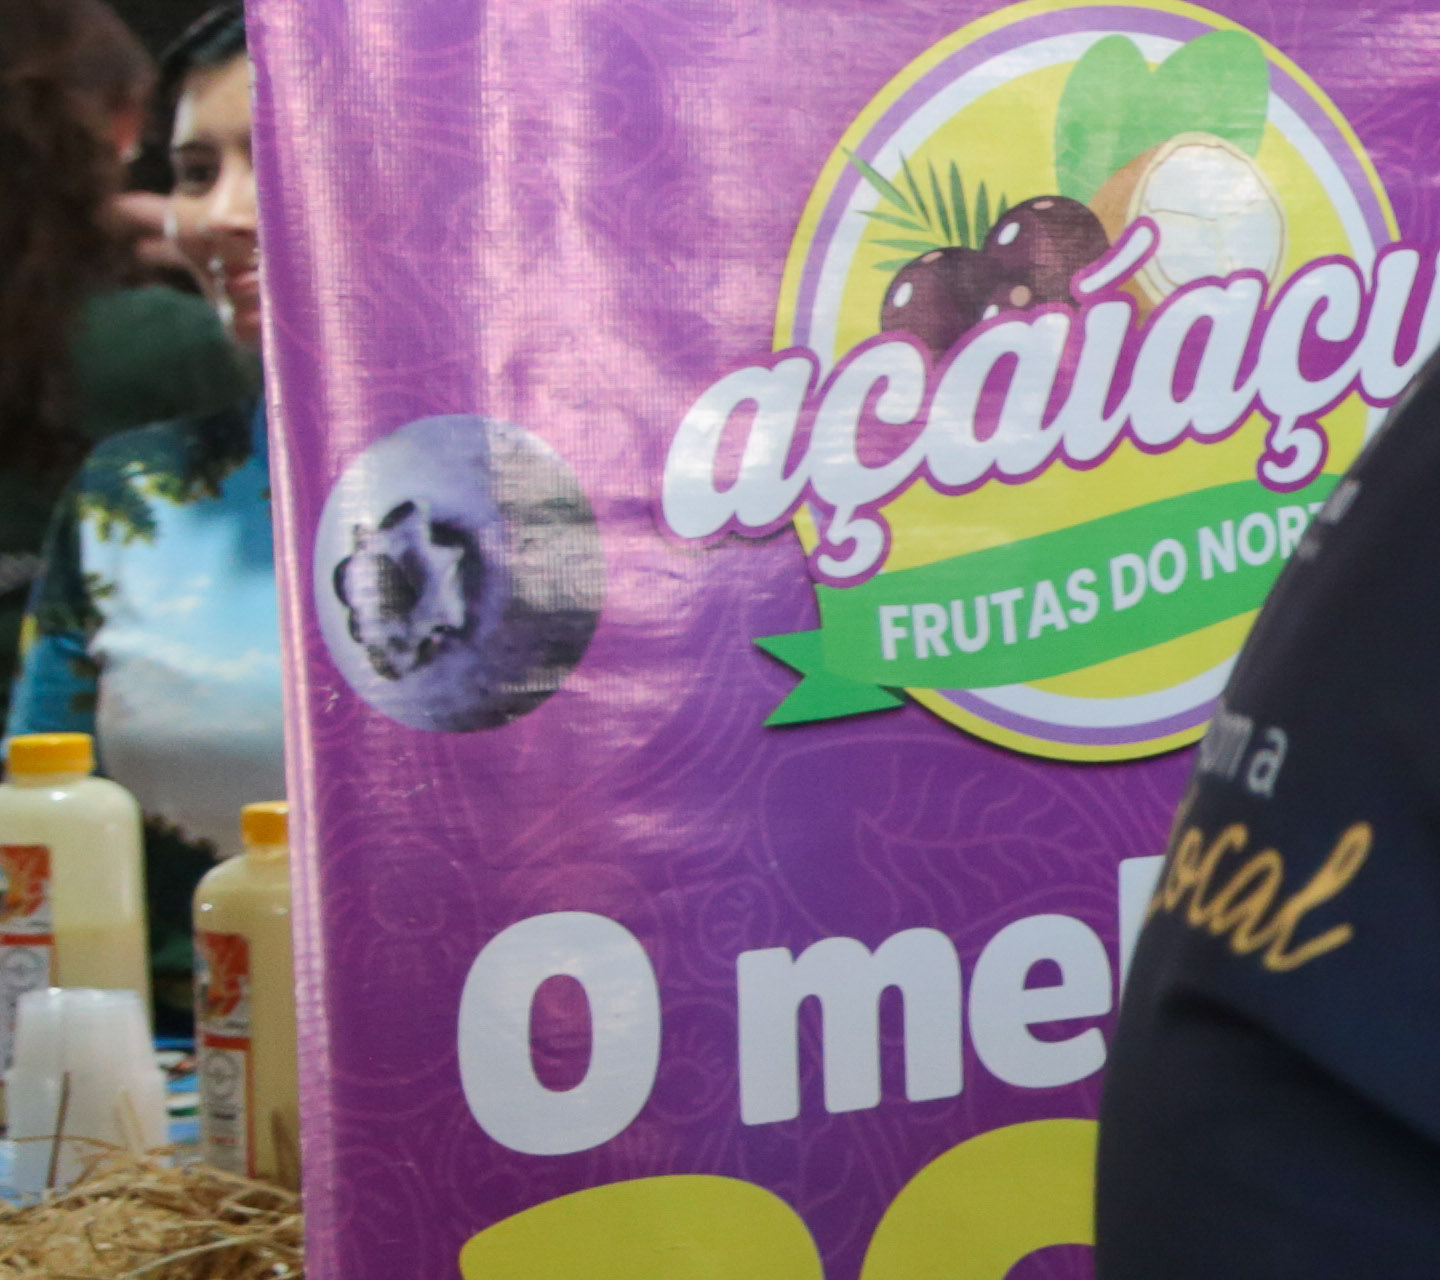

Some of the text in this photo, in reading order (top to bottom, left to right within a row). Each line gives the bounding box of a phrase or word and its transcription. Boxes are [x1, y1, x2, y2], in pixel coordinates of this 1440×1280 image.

[879, 572, 1101, 665] FRUTAS
[1110, 538, 1188, 611] DO
[1148, 821, 1374, 972] ocal
[457, 910, 662, 1156] O
